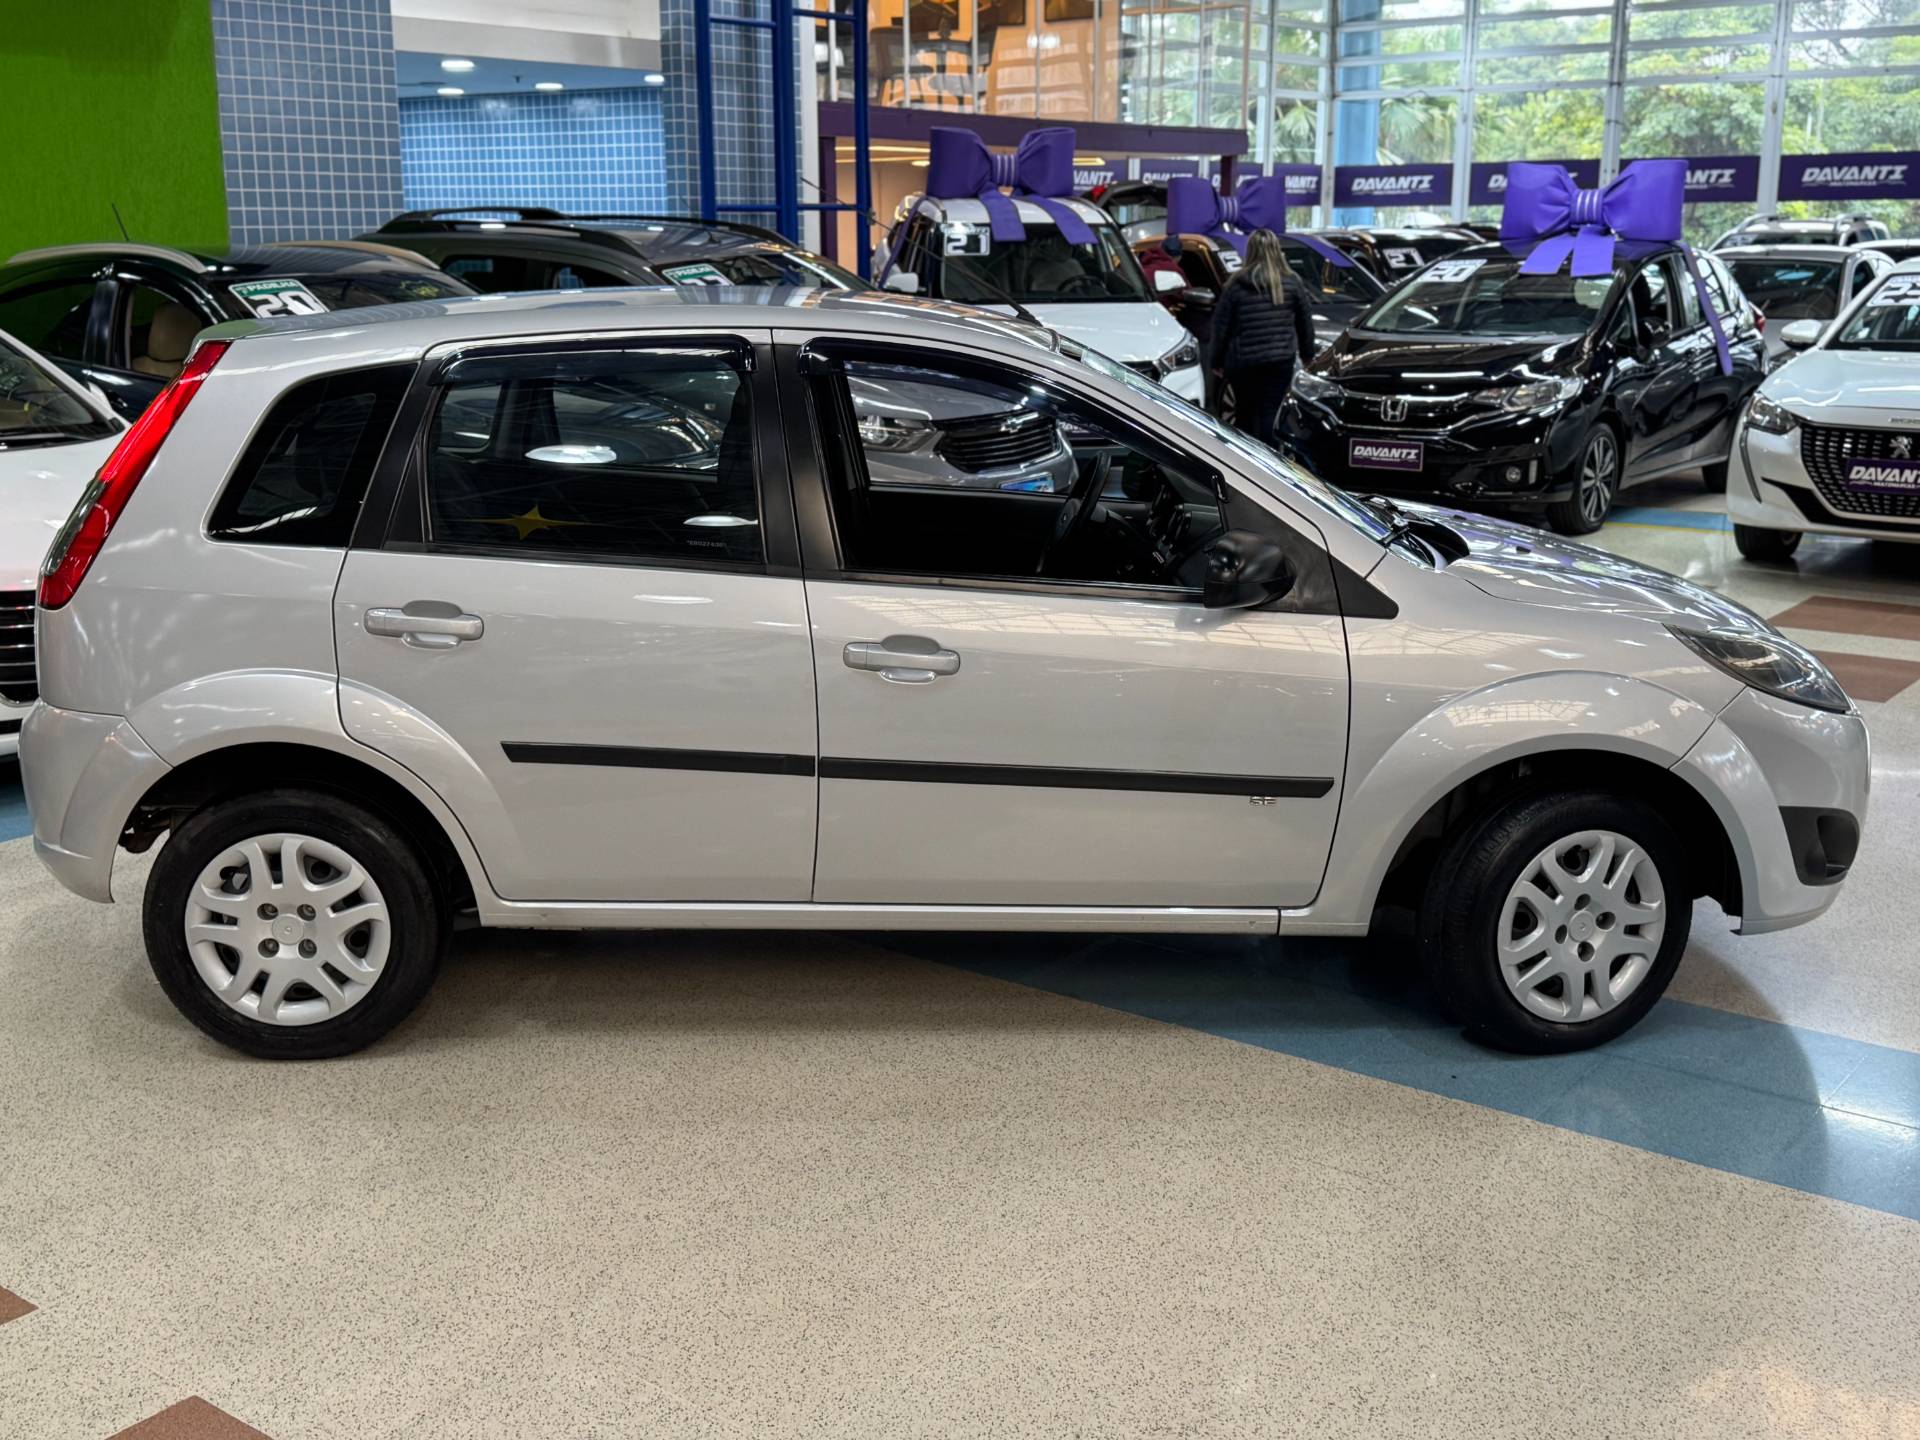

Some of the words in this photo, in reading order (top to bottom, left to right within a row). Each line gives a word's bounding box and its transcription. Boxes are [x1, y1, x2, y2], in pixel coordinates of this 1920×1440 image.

[1351, 174, 1434, 191] DAVANTI
[1801, 165, 1908, 183] DAVANTI
[946, 233, 988, 255] 21
[1422, 263, 1478, 282] 20
[248, 290, 326, 318] 20
[1353, 445, 1419, 460] DAVANTI
[1848, 465, 1920, 484] DAVAN
